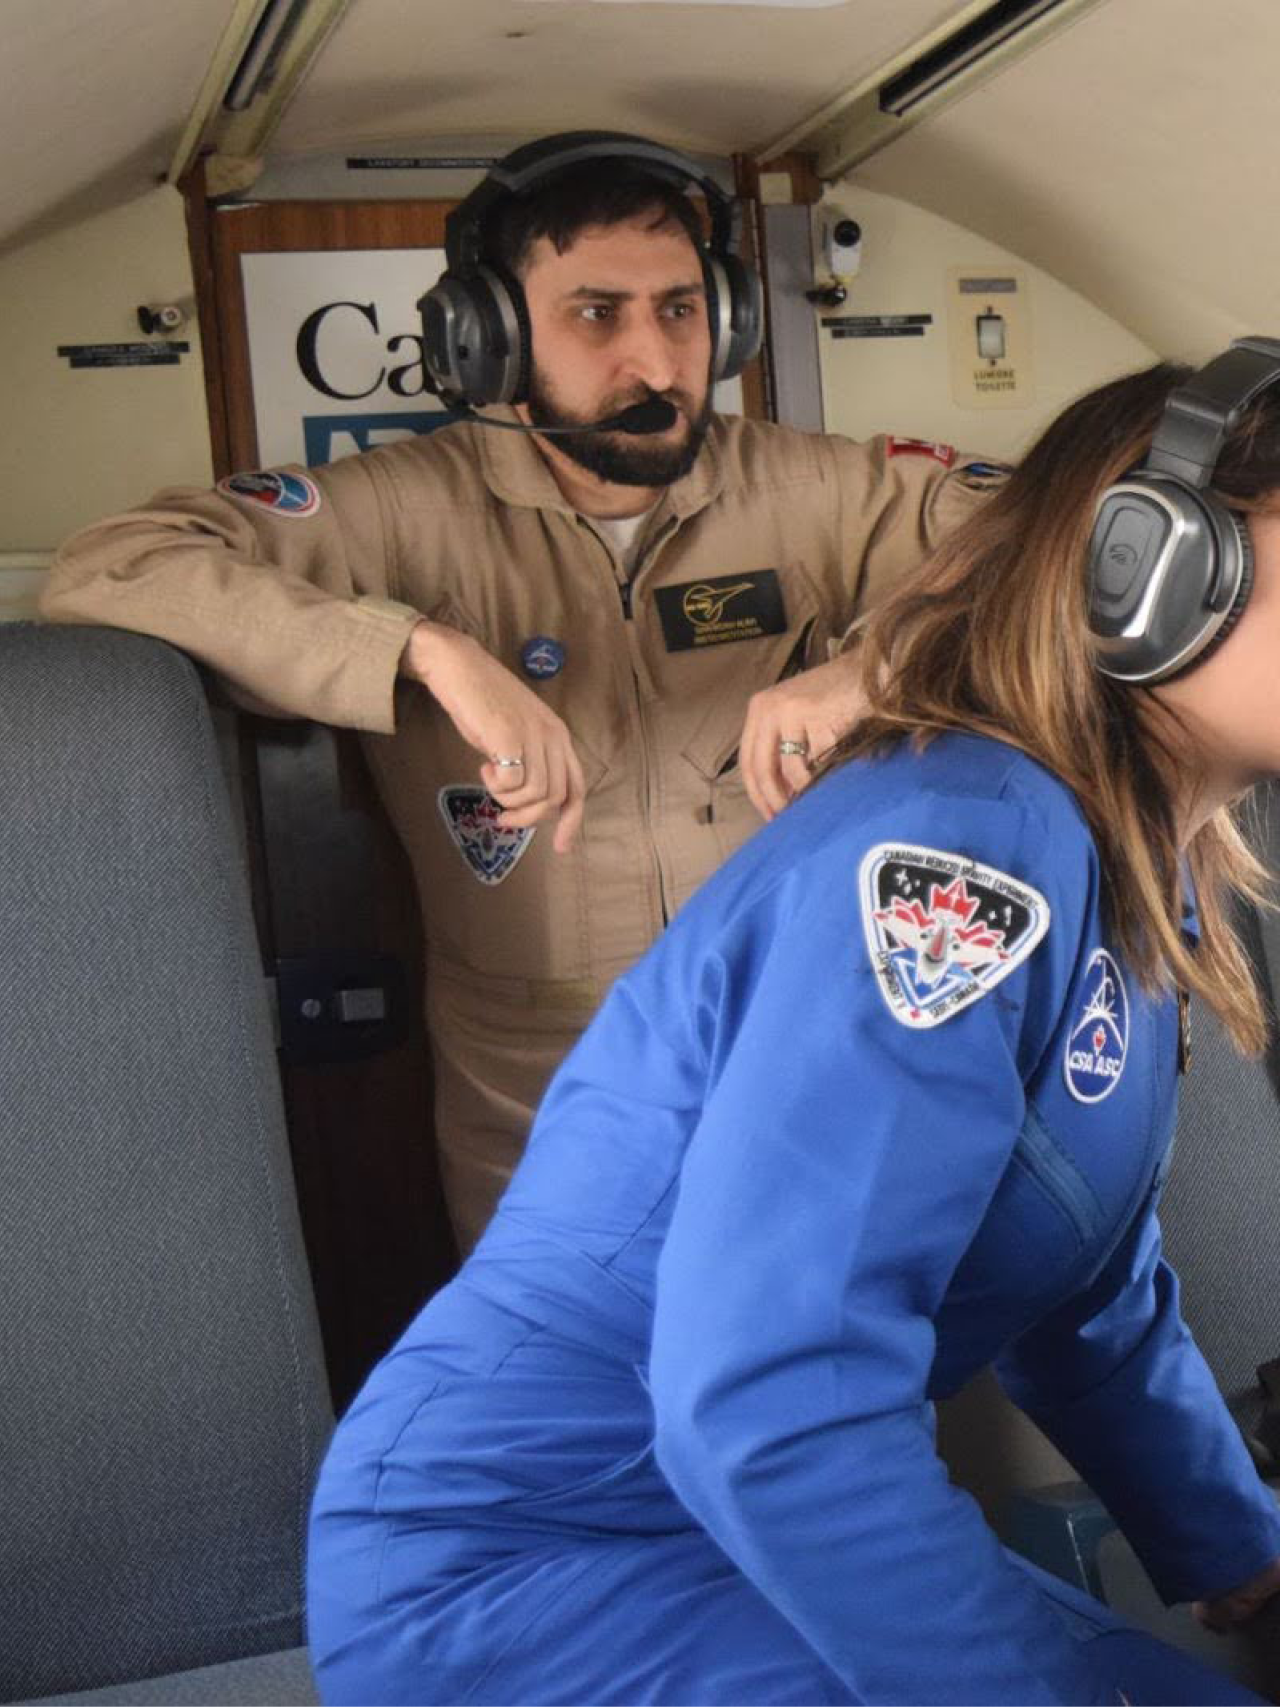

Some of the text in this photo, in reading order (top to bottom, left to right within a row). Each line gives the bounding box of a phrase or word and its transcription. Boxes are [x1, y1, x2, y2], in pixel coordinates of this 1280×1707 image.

[883, 850, 925, 866] CANADIAN
[1069, 1050, 1120, 1077] CSA ASC
